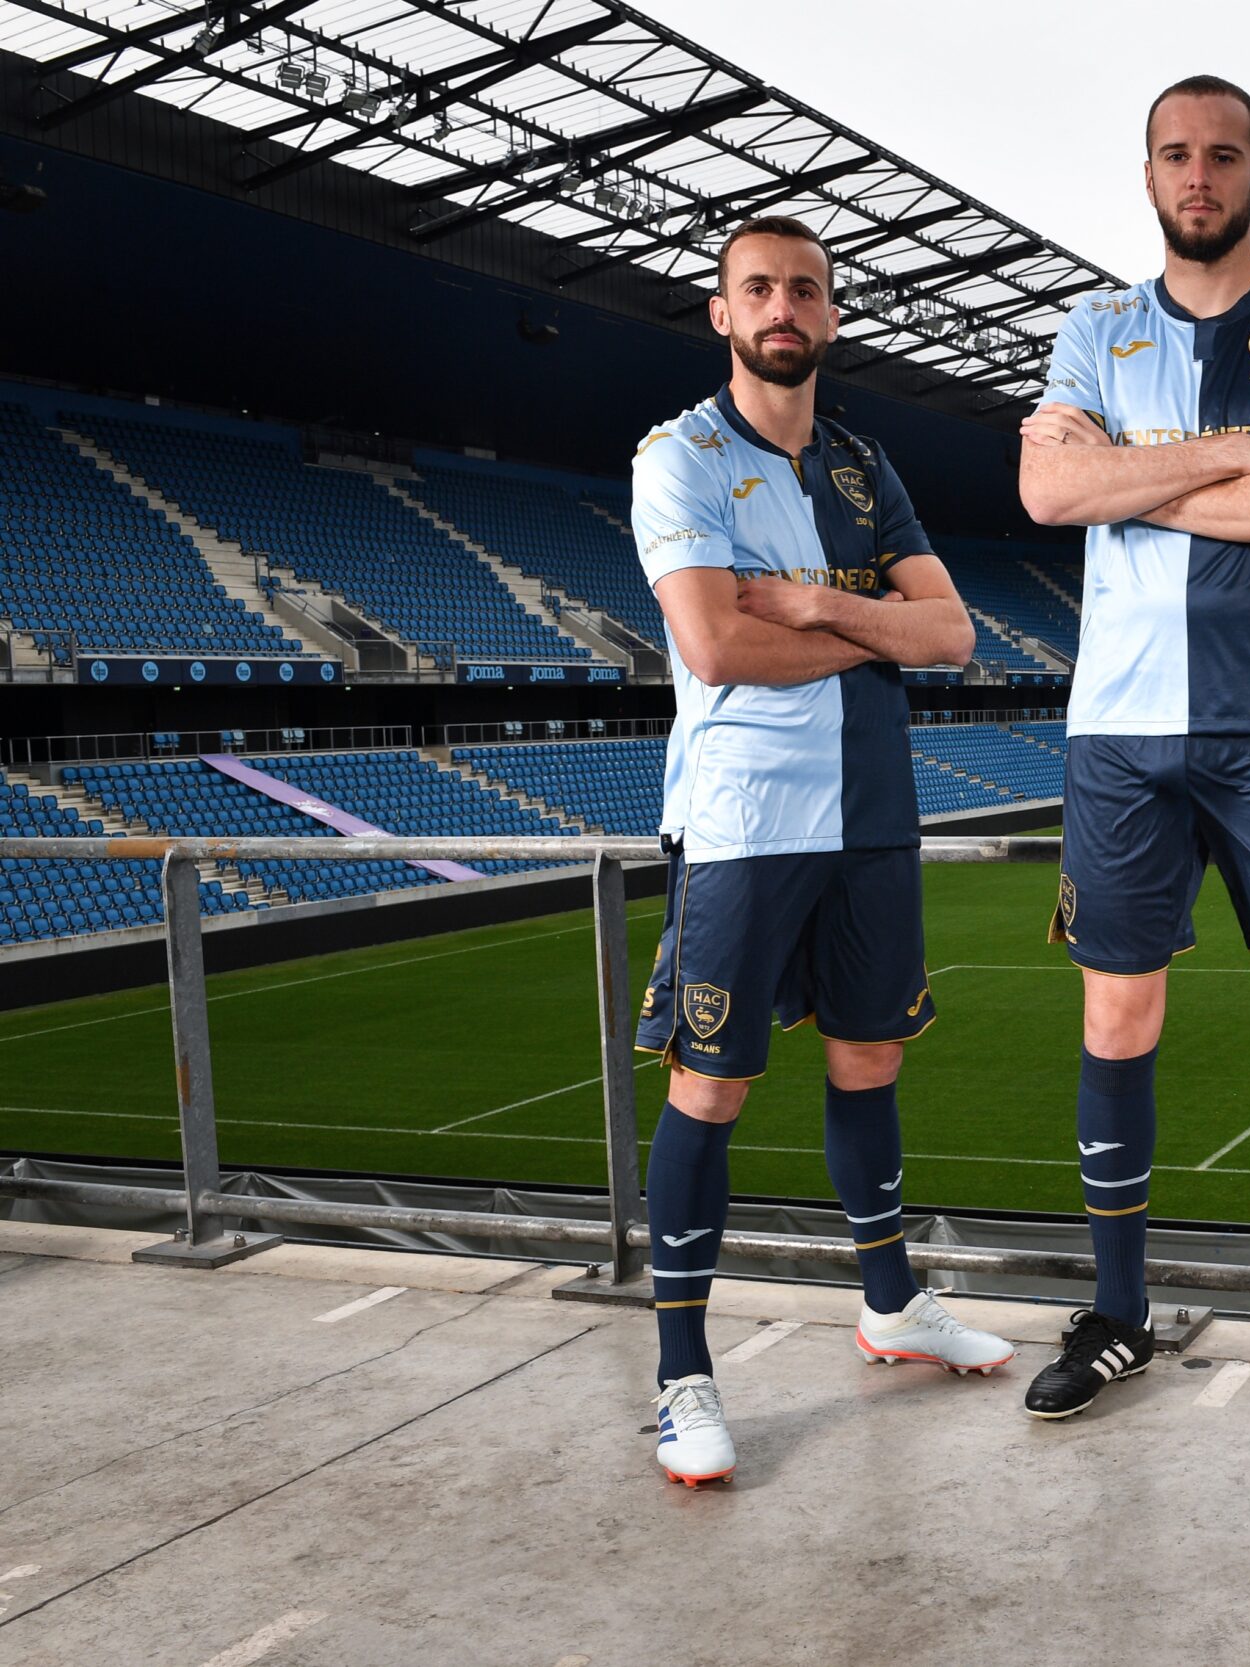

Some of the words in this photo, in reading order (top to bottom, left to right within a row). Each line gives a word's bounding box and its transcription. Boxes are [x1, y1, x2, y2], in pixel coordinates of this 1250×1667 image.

[839, 474, 865, 487] HAC
[693, 990, 721, 1006] HAC
[691, 1041, 703, 1051] 150
[703, 1044, 721, 1054] ANS
